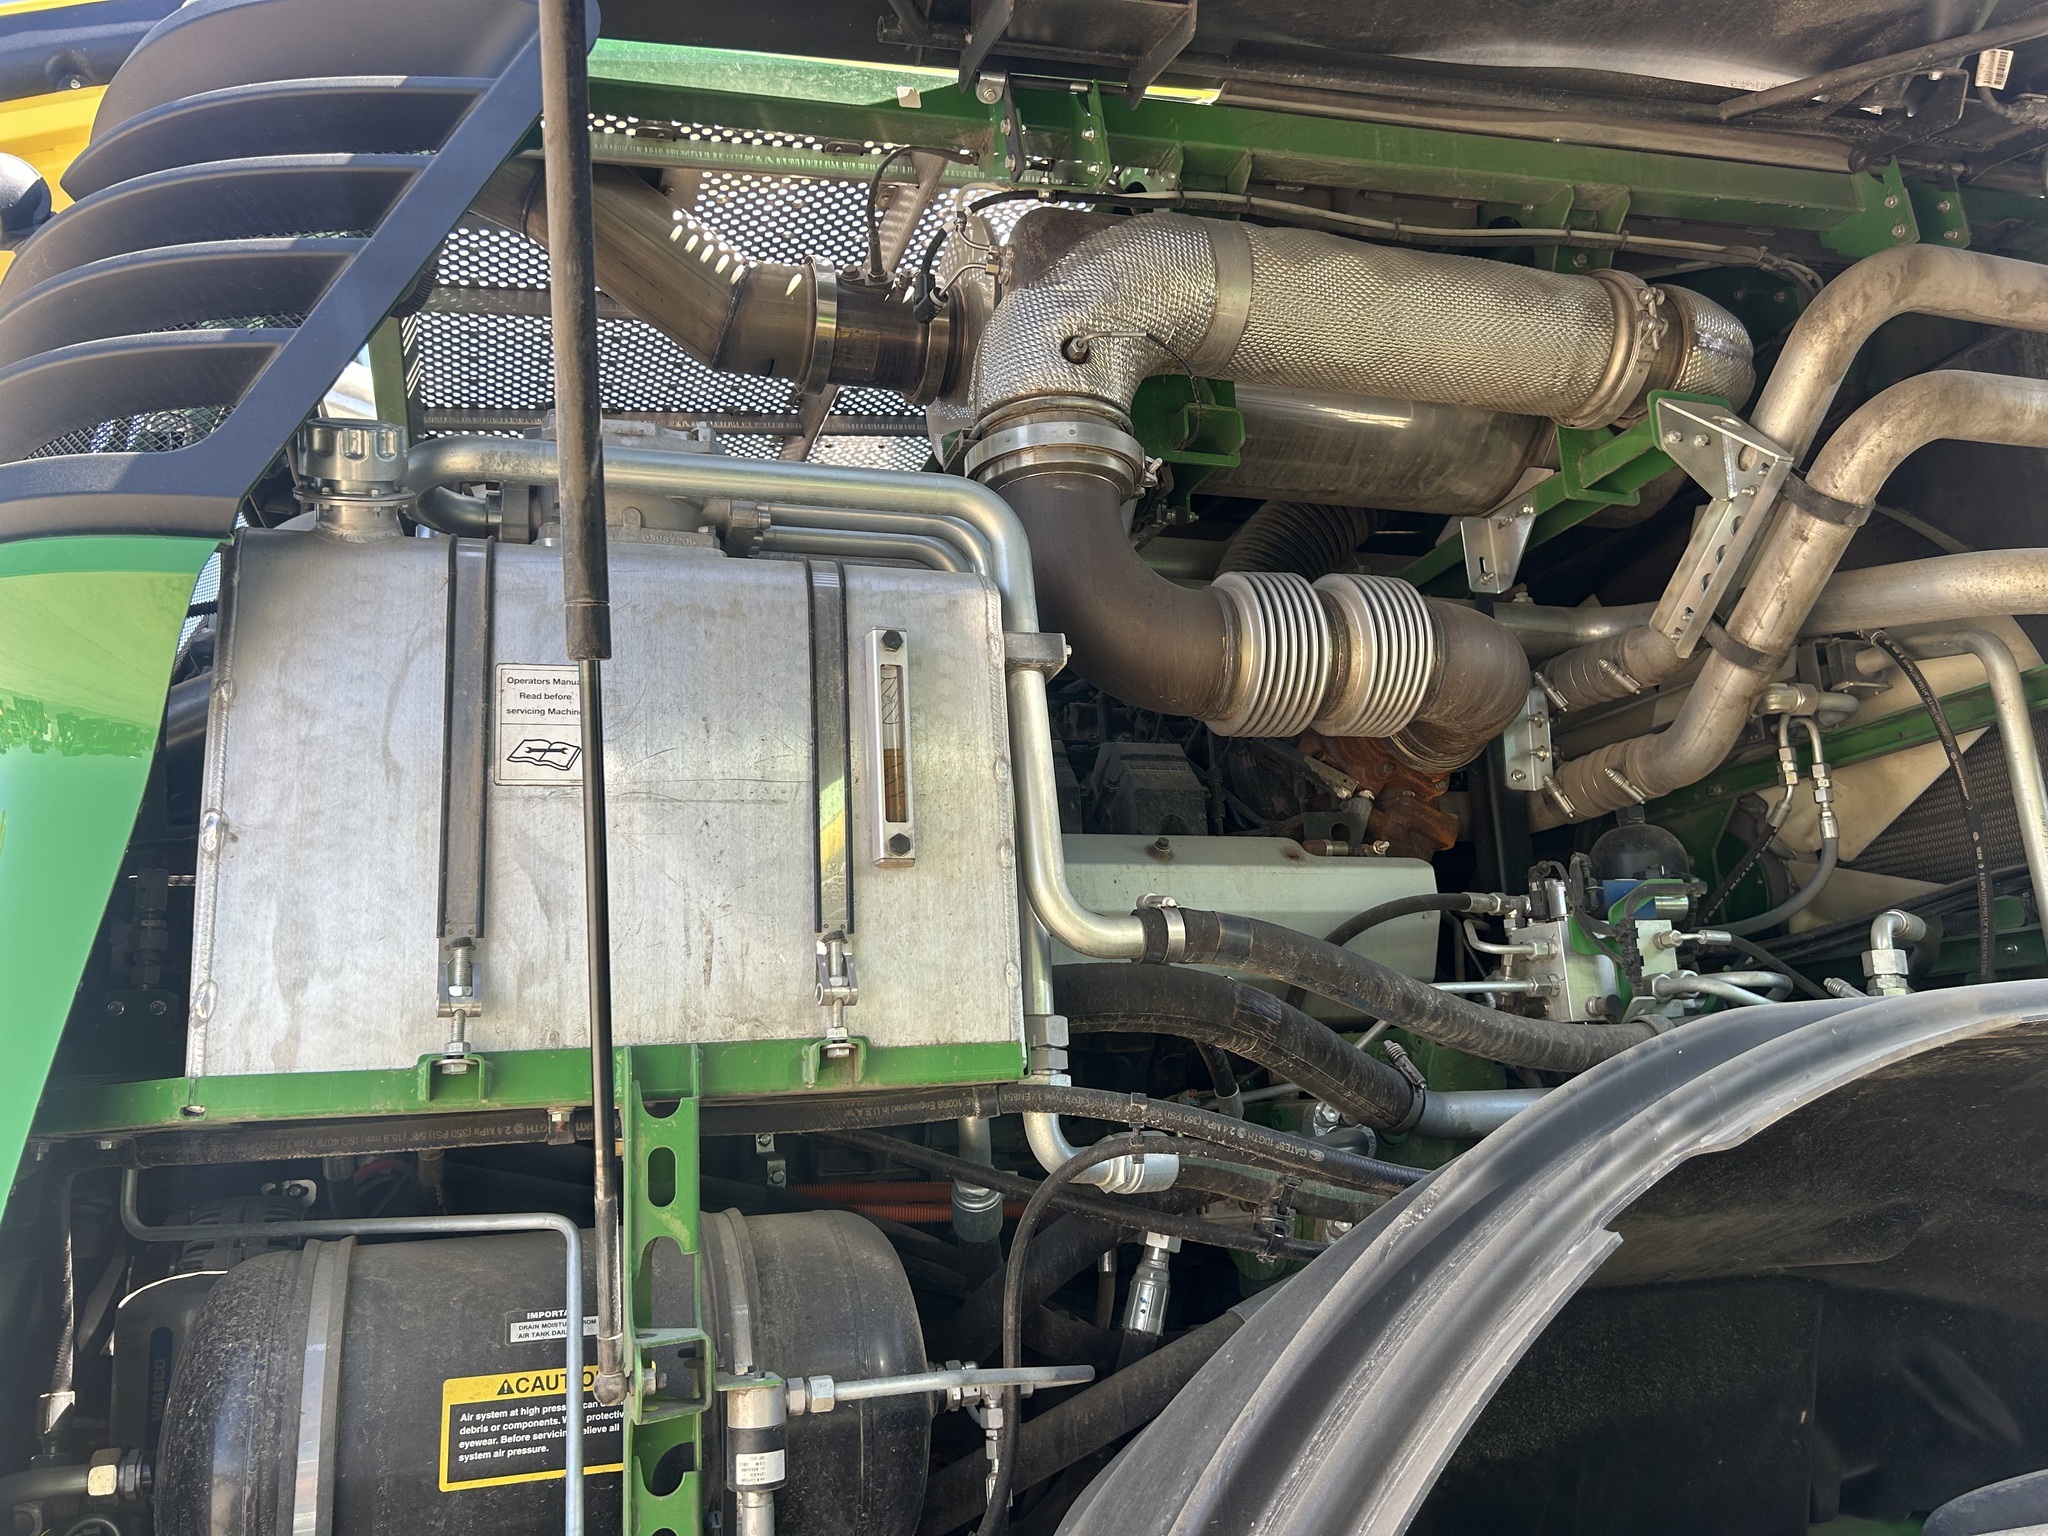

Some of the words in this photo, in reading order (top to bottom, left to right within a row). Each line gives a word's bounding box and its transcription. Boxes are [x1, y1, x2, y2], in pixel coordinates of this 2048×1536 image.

[507, 677, 550, 685] Operators
[520, 692, 542, 700] Read
[544, 693, 572, 701] before
[506, 708, 545, 716] servicing
[892, 1102, 935, 1115] Engineered
[1164, 1108, 1182, 1120] PSI)
[1184, 1114, 1202, 1125] (350
[474, 1127, 494, 1136] MPa
[498, 1125, 511, 1135] 2.4
[1203, 1121, 1221, 1132] MPa
[361, 1133, 381, 1144] mm)
[384, 1131, 406, 1144] (15.9
[428, 1129, 449, 1140] PSI)
[451, 1127, 472, 1139] (350
[317, 1137, 340, 1148] 4079
[342, 1137, 358, 1146] ISO
[152, 1359, 166, 1421] WABCO
[460, 1413, 474, 1421] Air
[476, 1410, 508, 1421] system
[510, 1408, 519, 1416] at
[521, 1406, 540, 1416] high
[460, 1424, 489, 1435] debris
[503, 1418, 561, 1430] components.
[587, 1411, 624, 1423] protectiv
[459, 1437, 499, 1450] eyewear.
[501, 1434, 531, 1443] Before
[609, 1423, 620, 1432] all
[459, 1452, 492, 1463] system
[493, 1449, 506, 1458] air
[507, 1445, 549, 1458] pressure.
